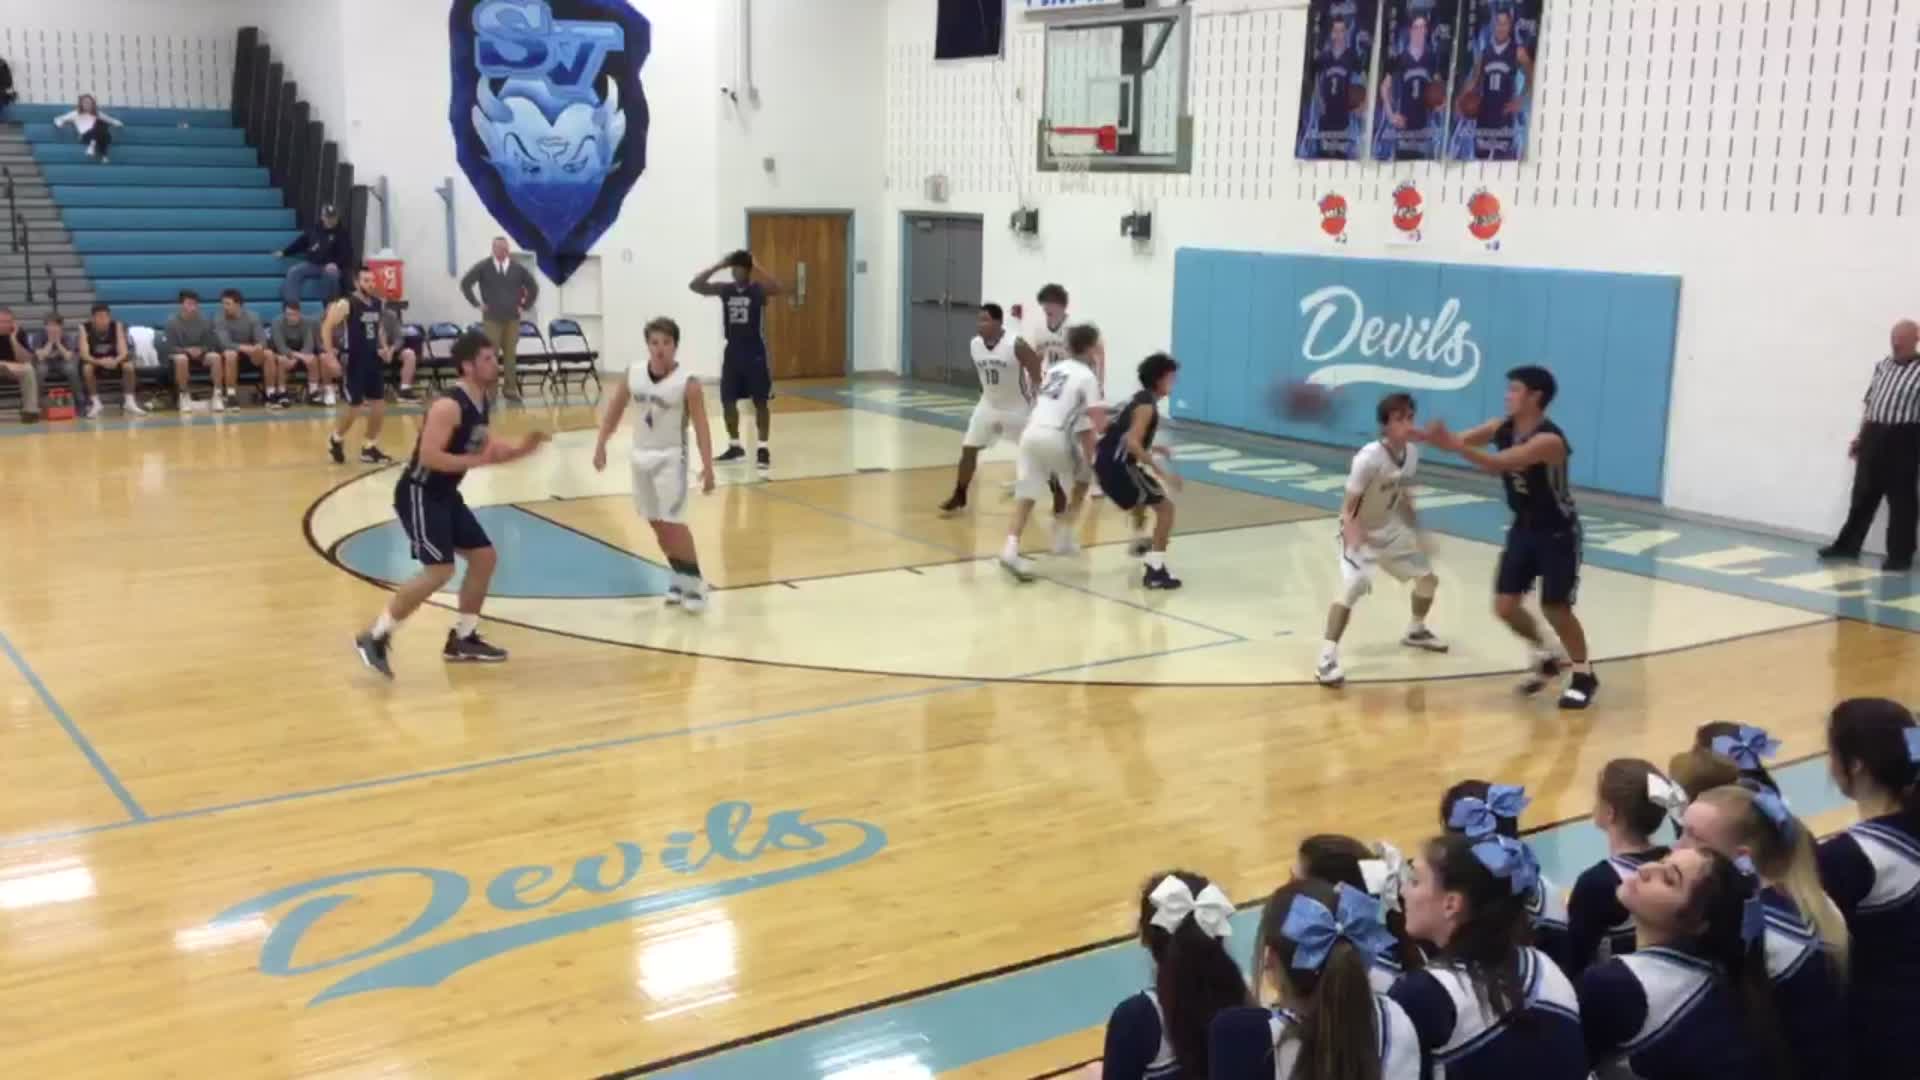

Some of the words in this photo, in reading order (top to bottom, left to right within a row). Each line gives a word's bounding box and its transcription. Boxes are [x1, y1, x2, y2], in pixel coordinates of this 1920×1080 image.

[729, 306, 749, 324] 23
[1300, 285, 1481, 390] Devils
[985, 368, 999, 385] 10
[205, 800, 888, 1008] Devils
